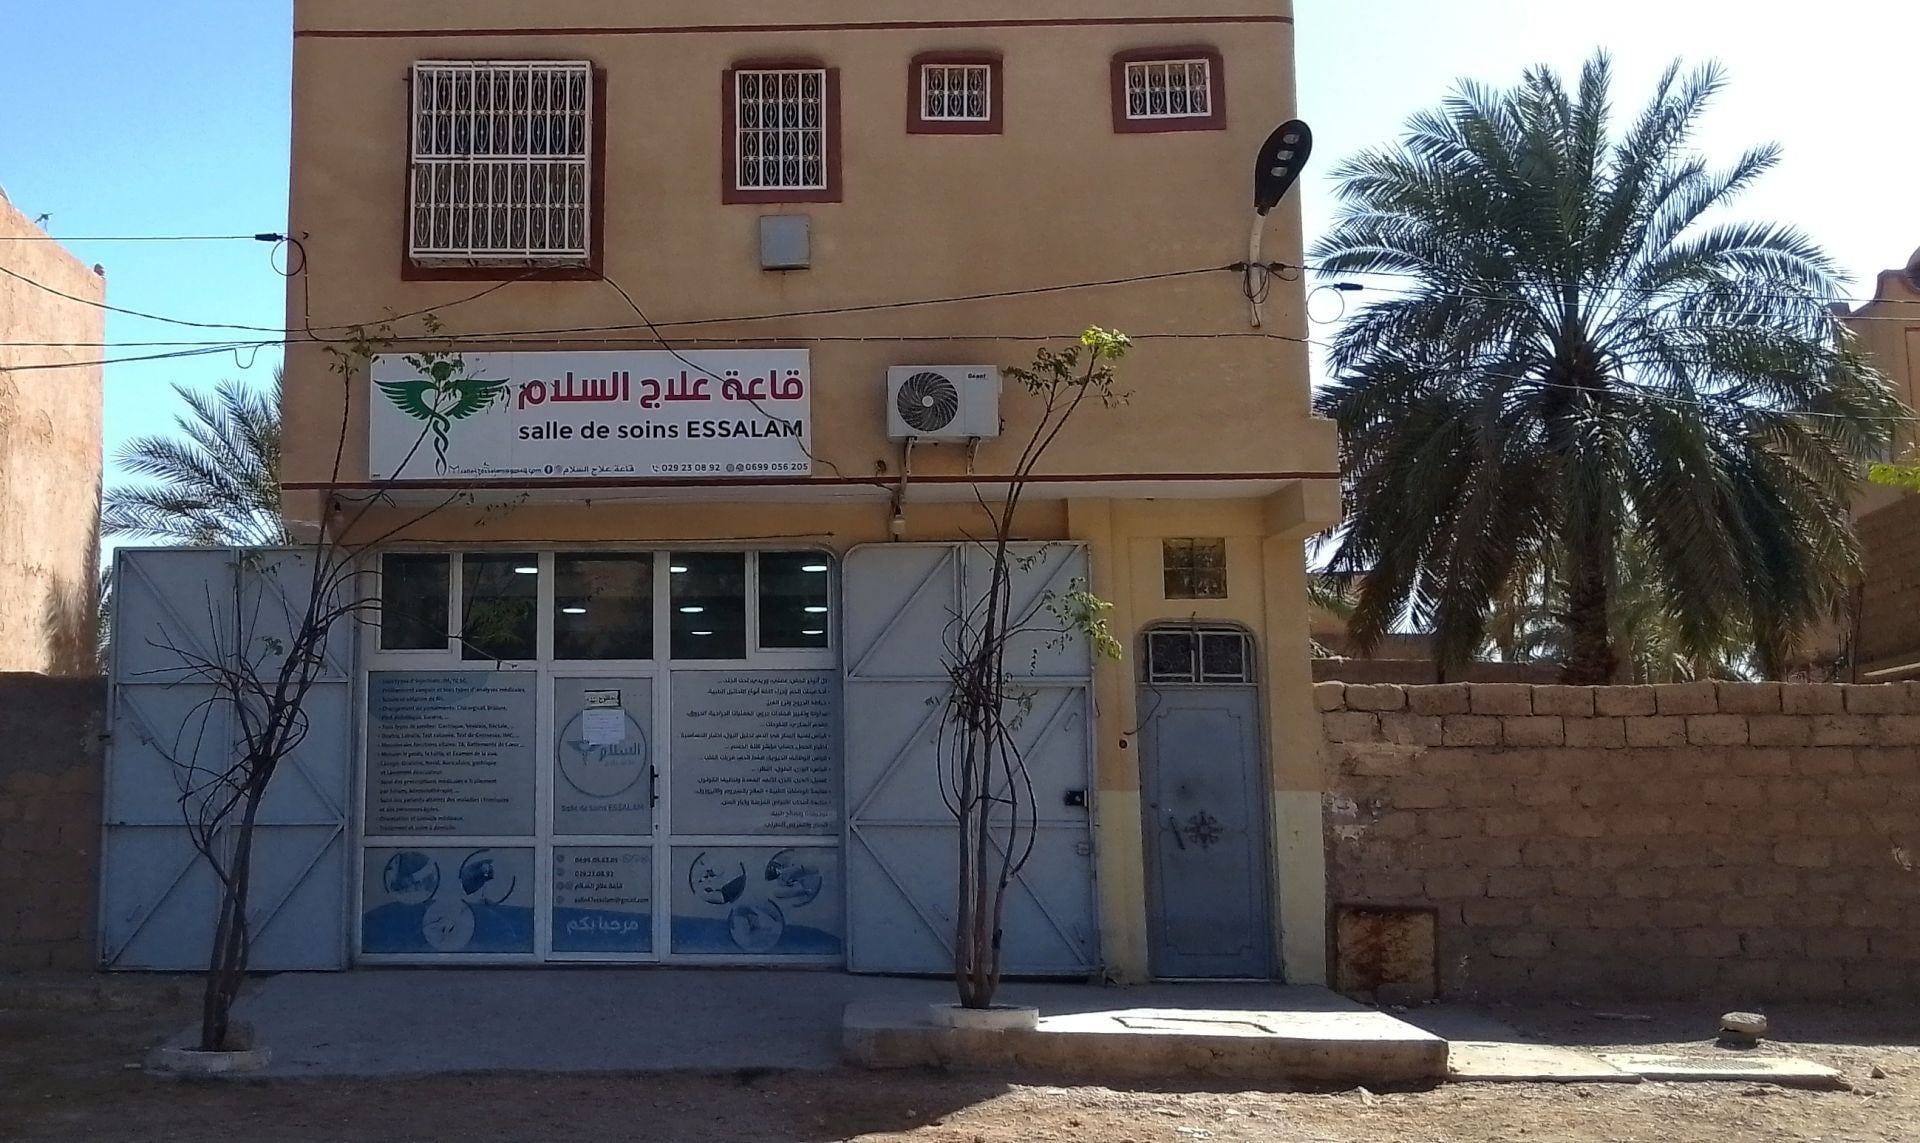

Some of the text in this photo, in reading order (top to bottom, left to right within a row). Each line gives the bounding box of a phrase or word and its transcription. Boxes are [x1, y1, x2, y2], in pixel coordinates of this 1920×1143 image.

[518, 370, 804, 410] قاعة علاج السلام
[518, 420, 803, 440] salle de soins ESSALAM
[681, 463, 693, 472] 23
[709, 463, 720, 472] 92
[745, 462, 808, 471] 0699 056 205
[566, 915, 639, 936] مرحبا بكم
